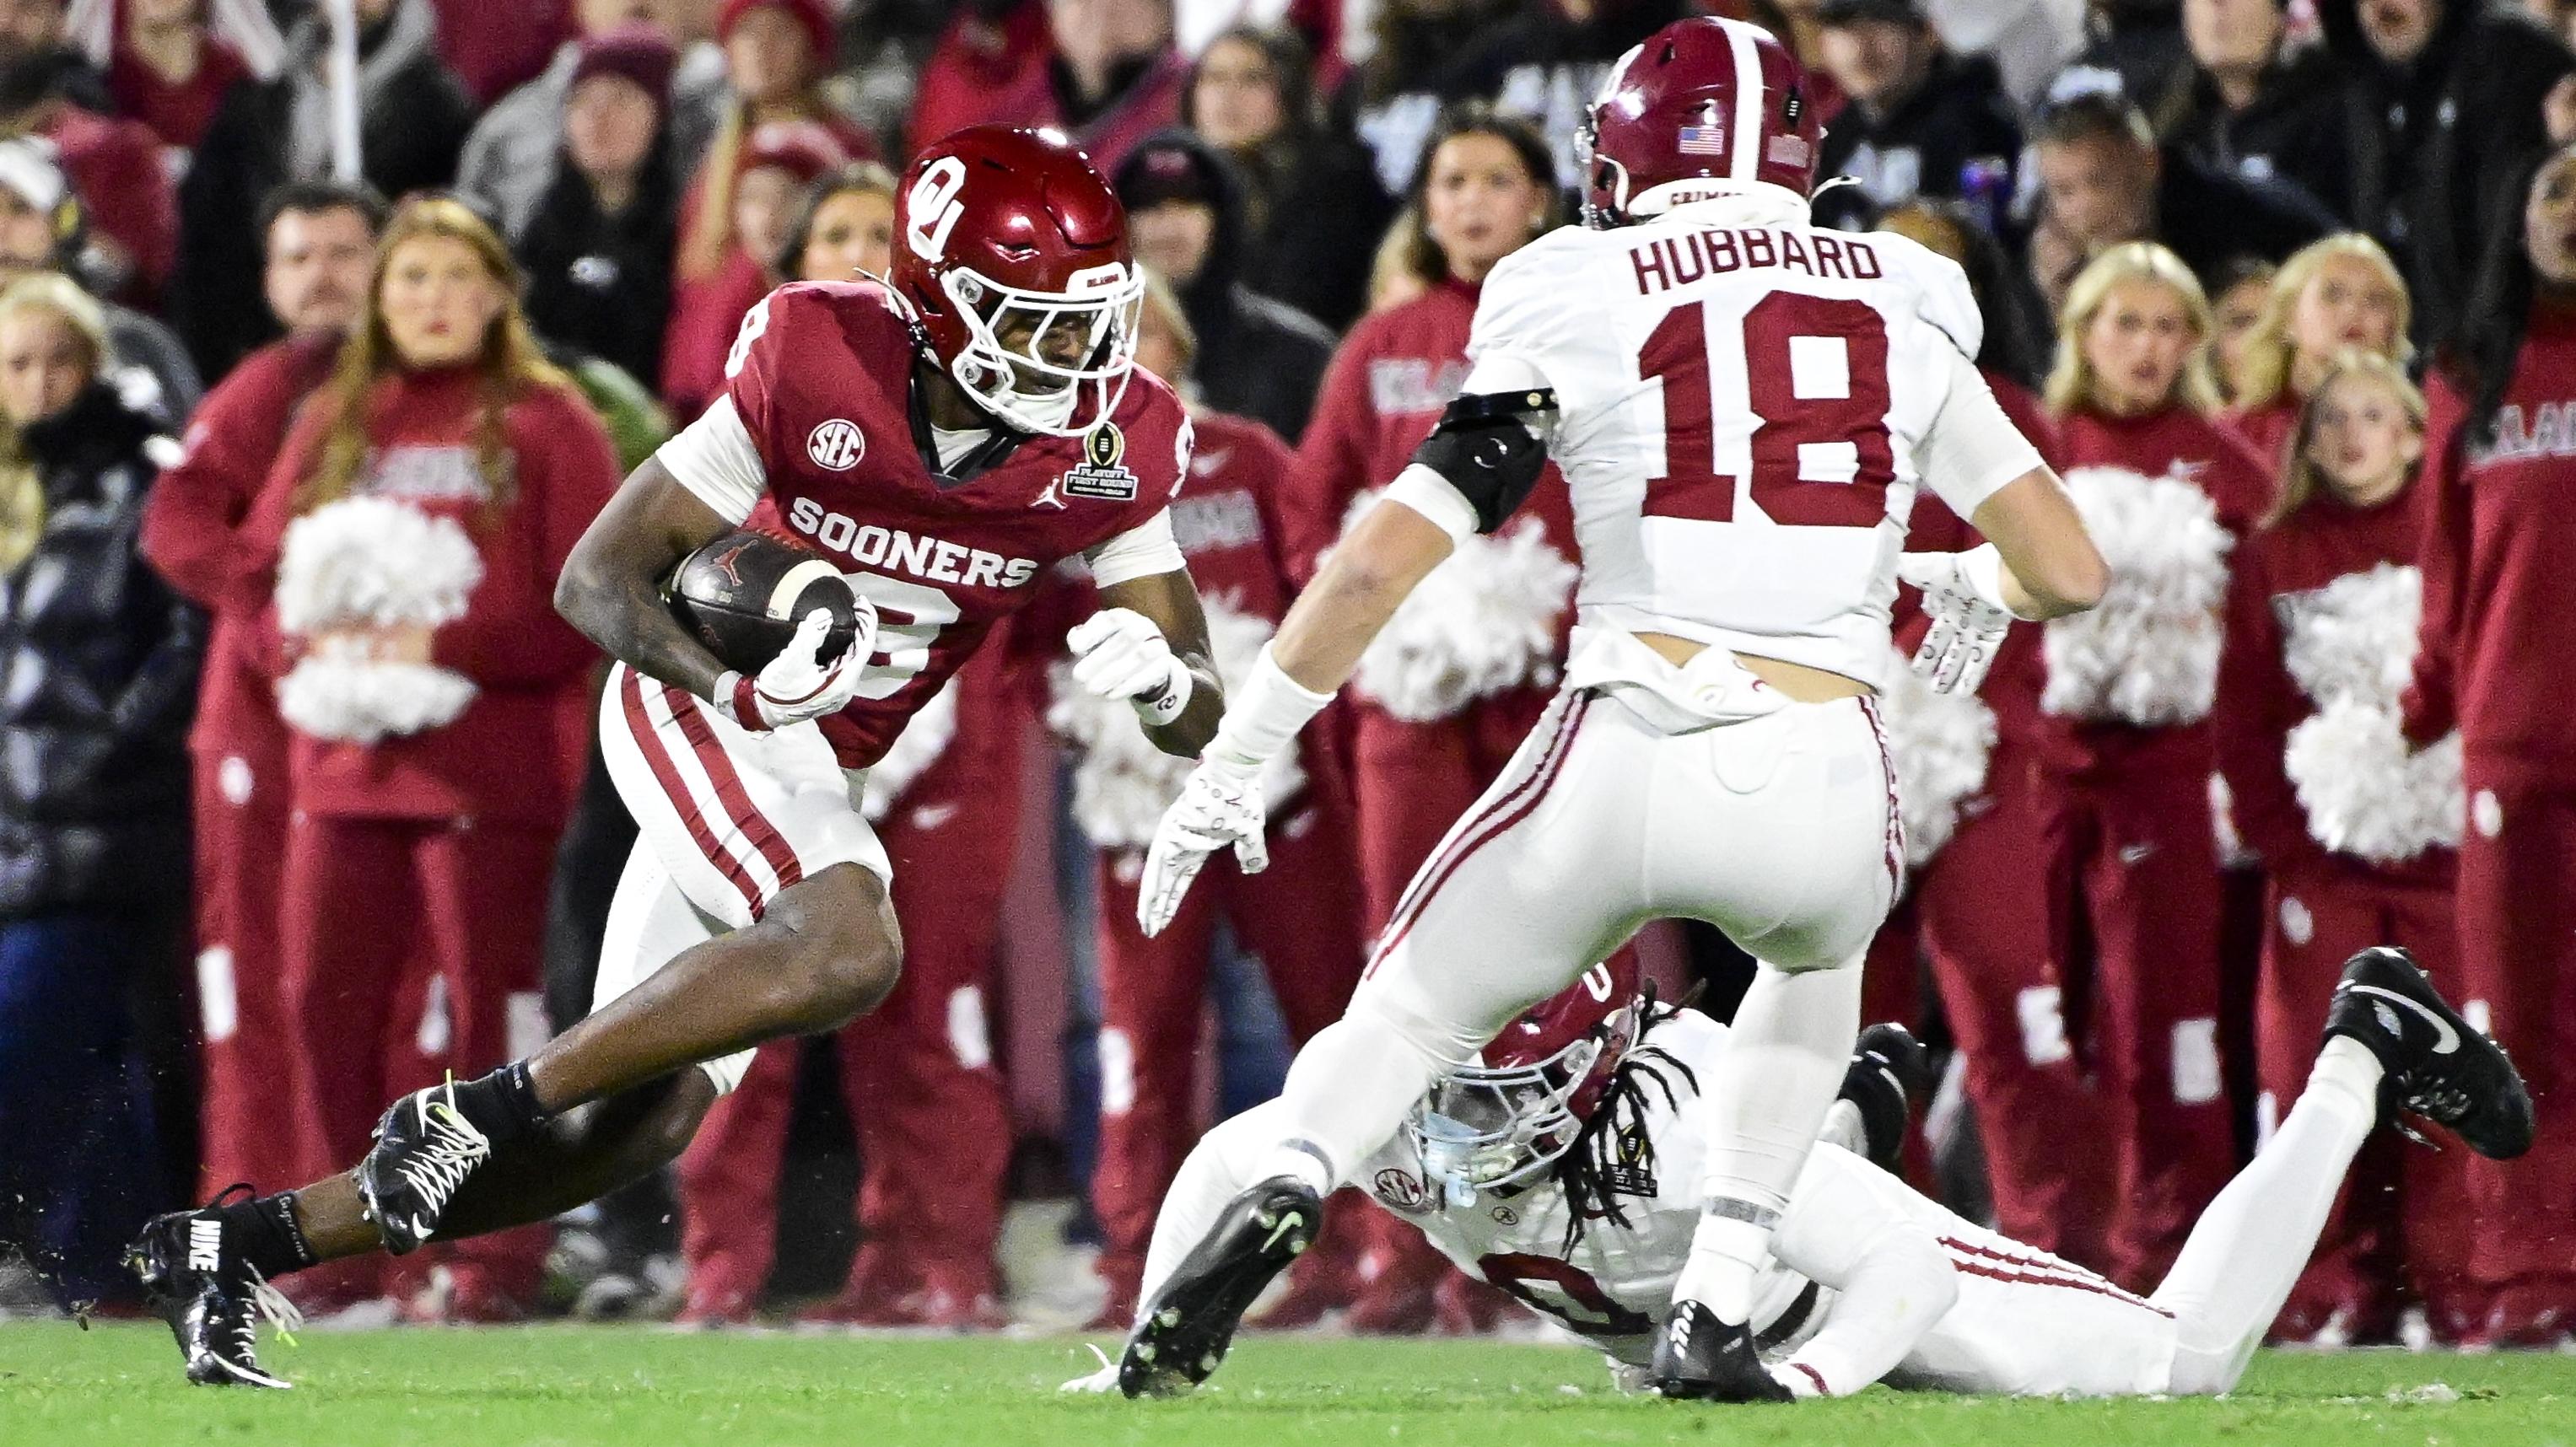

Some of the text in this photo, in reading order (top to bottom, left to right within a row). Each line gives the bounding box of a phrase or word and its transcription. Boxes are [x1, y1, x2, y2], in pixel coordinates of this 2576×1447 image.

[1630, 229, 1883, 295] HUBBARD
[1637, 289, 1896, 528] 18
[811, 422, 862, 468] SEC
[790, 496, 1038, 589] SOONERS
[1377, 1170, 1420, 1205] SEC
[188, 1218, 222, 1272] NIKE
